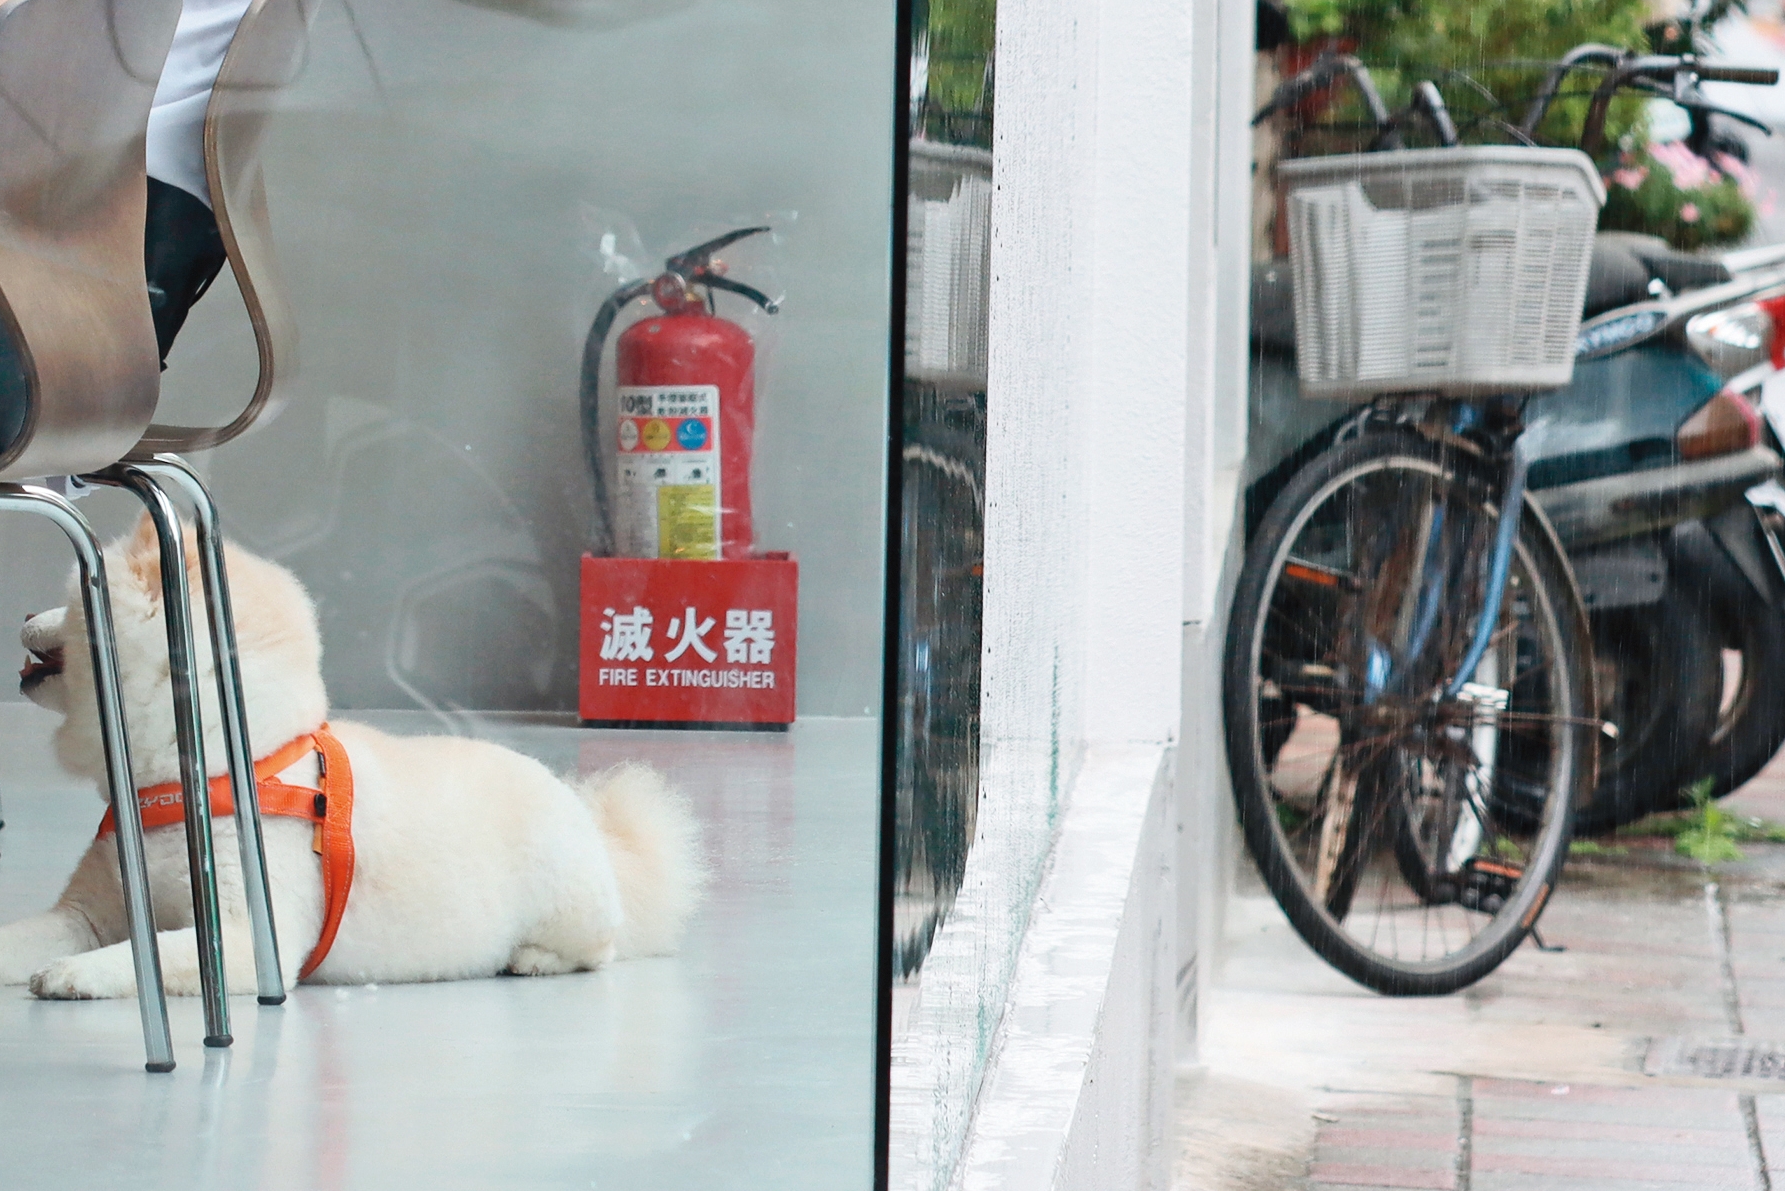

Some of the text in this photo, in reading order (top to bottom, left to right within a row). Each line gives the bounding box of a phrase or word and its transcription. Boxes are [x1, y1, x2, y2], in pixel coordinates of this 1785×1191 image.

[599, 606, 776, 665] 滅火器
[598, 667, 776, 689] FIRE EXTINGUISHER
